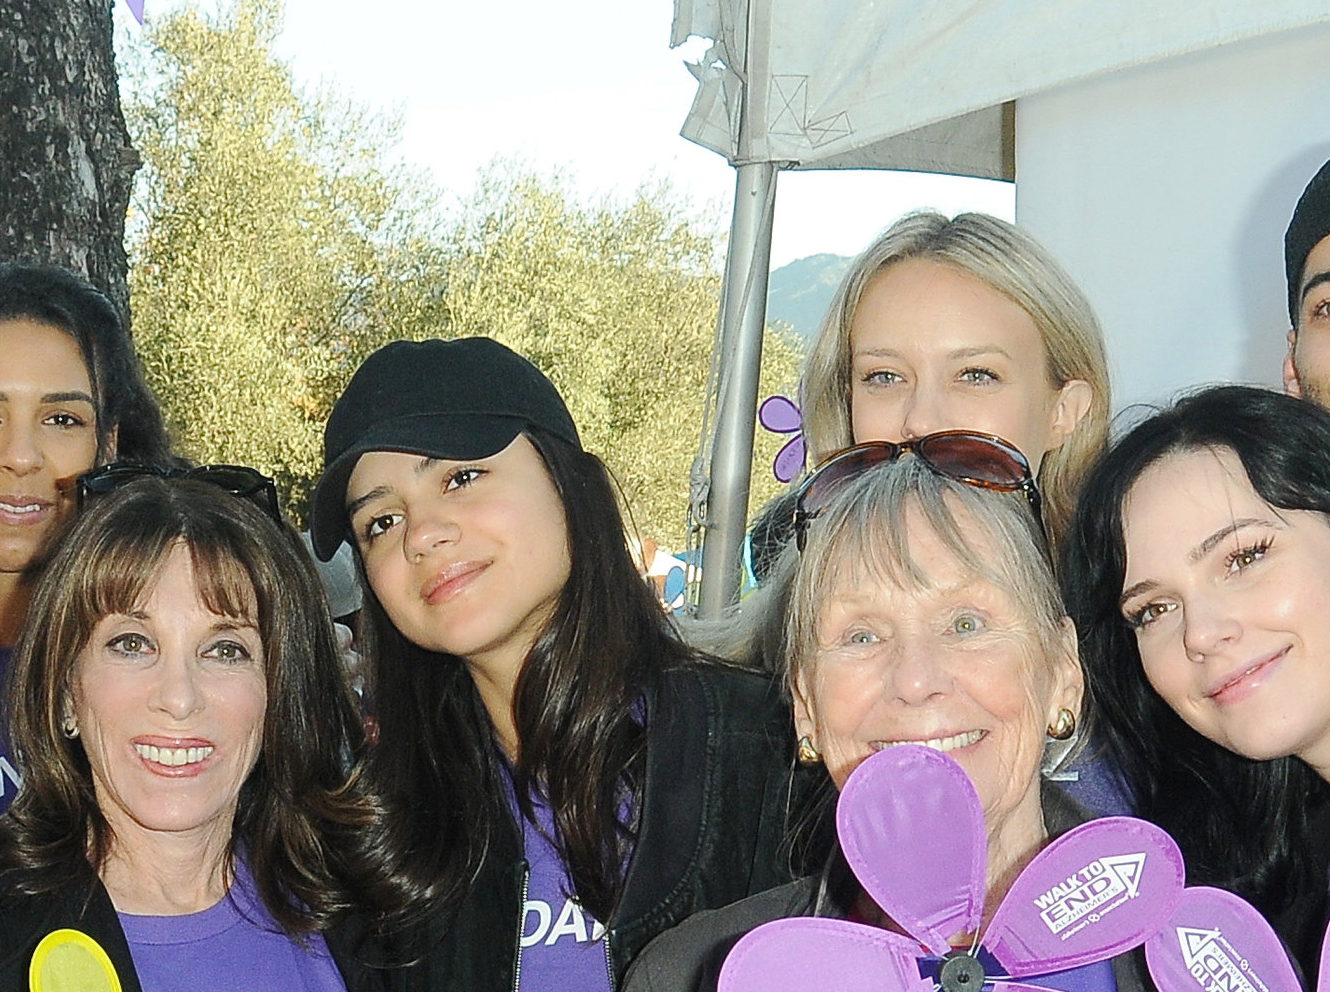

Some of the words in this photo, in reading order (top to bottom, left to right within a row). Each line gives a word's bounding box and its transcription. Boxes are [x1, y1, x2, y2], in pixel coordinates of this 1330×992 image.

[1033, 874, 1083, 910] WALK
[1078, 861, 1104, 881] TO
[1046, 877, 1111, 923] END
[1190, 963, 1210, 986] TO
